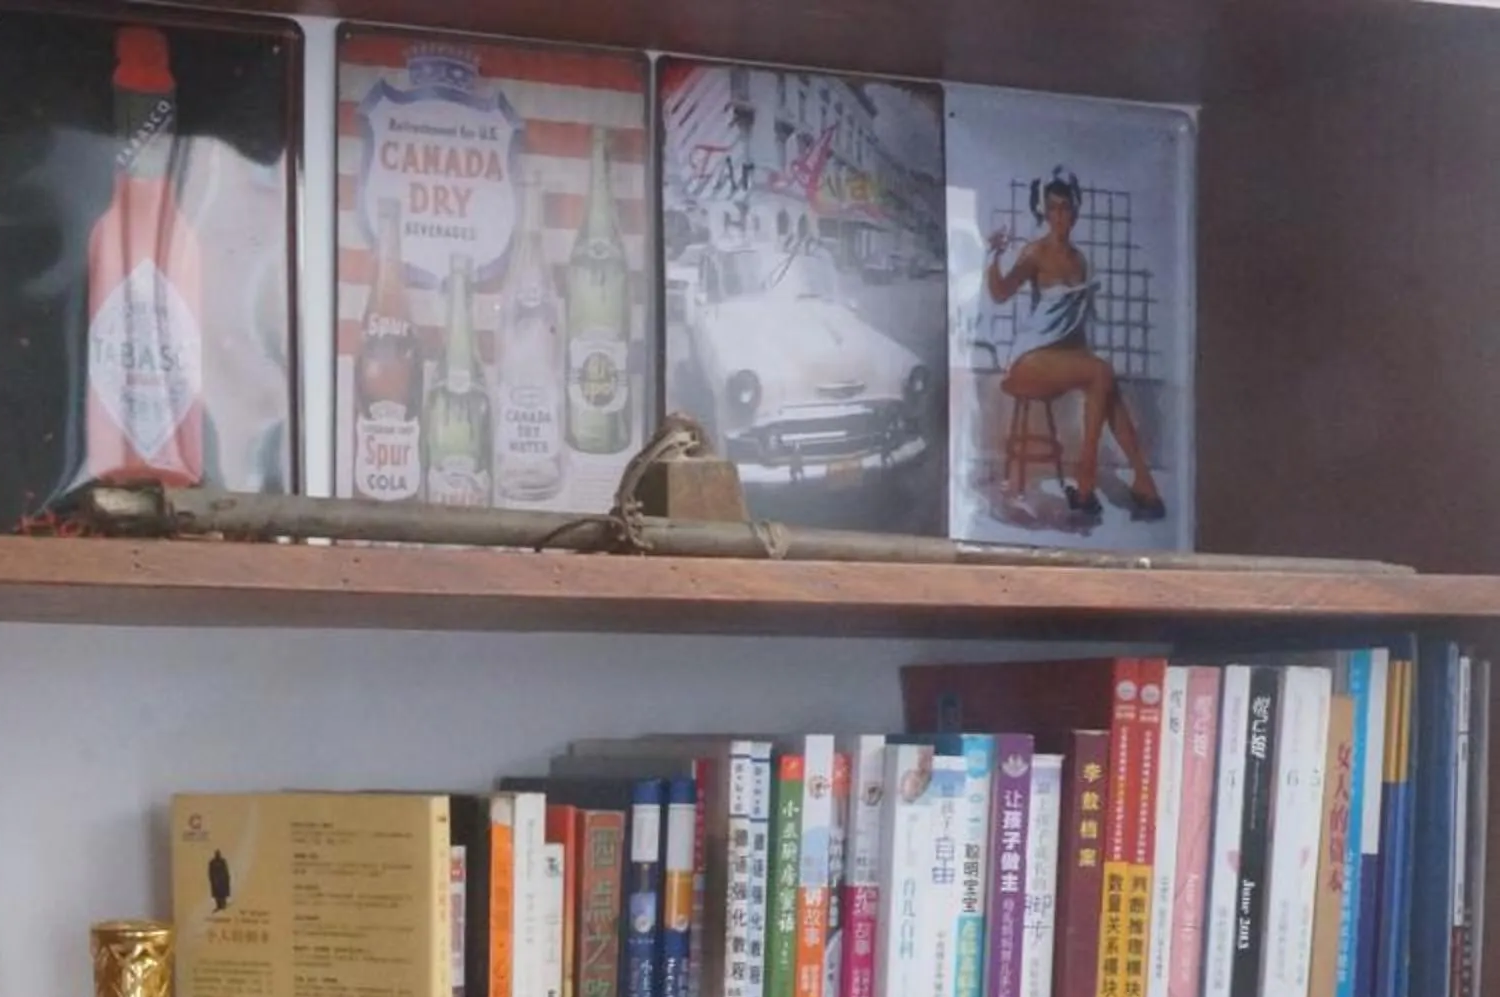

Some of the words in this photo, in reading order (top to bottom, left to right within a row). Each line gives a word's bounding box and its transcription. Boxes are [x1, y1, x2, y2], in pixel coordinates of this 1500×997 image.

[380, 140, 504, 181] CANADA
[408, 181, 474, 219] DRY
[92, 333, 188, 372] TABASC
[365, 435, 412, 470] Spur
[366, 474, 408, 492] COLA
[1000, 790, 1023, 893] 让孩子做主
